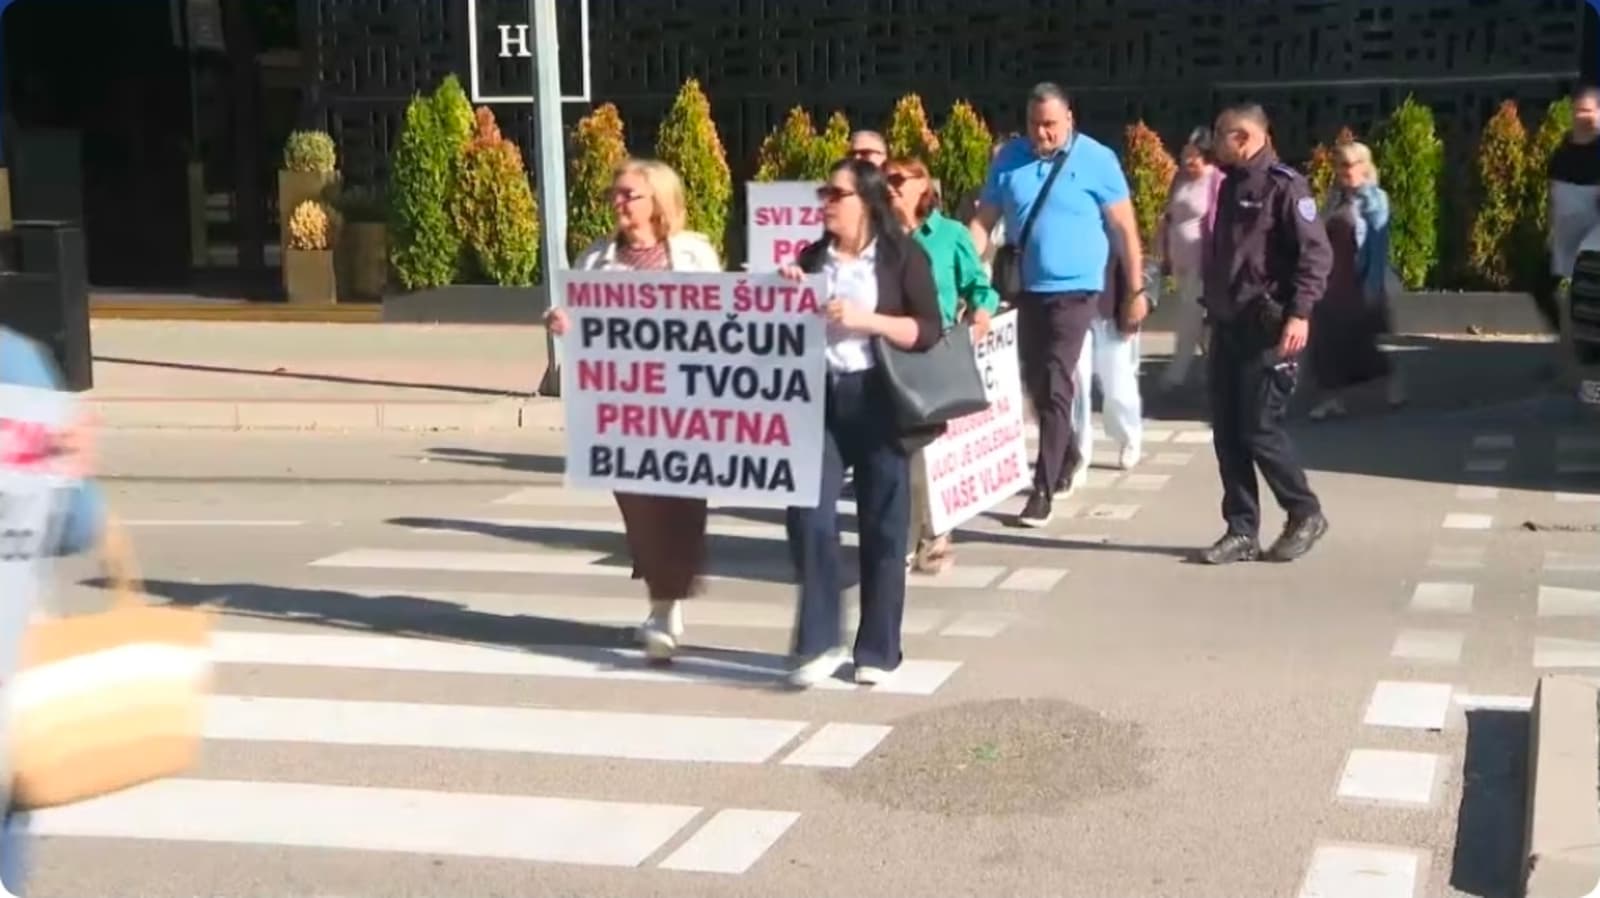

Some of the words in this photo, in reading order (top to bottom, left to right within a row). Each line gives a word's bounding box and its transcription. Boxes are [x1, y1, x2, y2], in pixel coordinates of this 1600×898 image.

[755, 206, 792, 226] SVI
[798, 206, 826, 226] ZA
[566, 282, 721, 311] MINISTRE
[733, 280, 820, 313] ŠUTA
[581, 314, 805, 357] PRORAČUN
[976, 322, 1014, 359] ERKO
[577, 360, 667, 394] NIJE
[679, 364, 811, 402] TVOJA
[596, 403, 790, 446] PRIVATNA
[589, 445, 796, 493] BLAGAJNA
[979, 451, 1021, 496] VLADE
